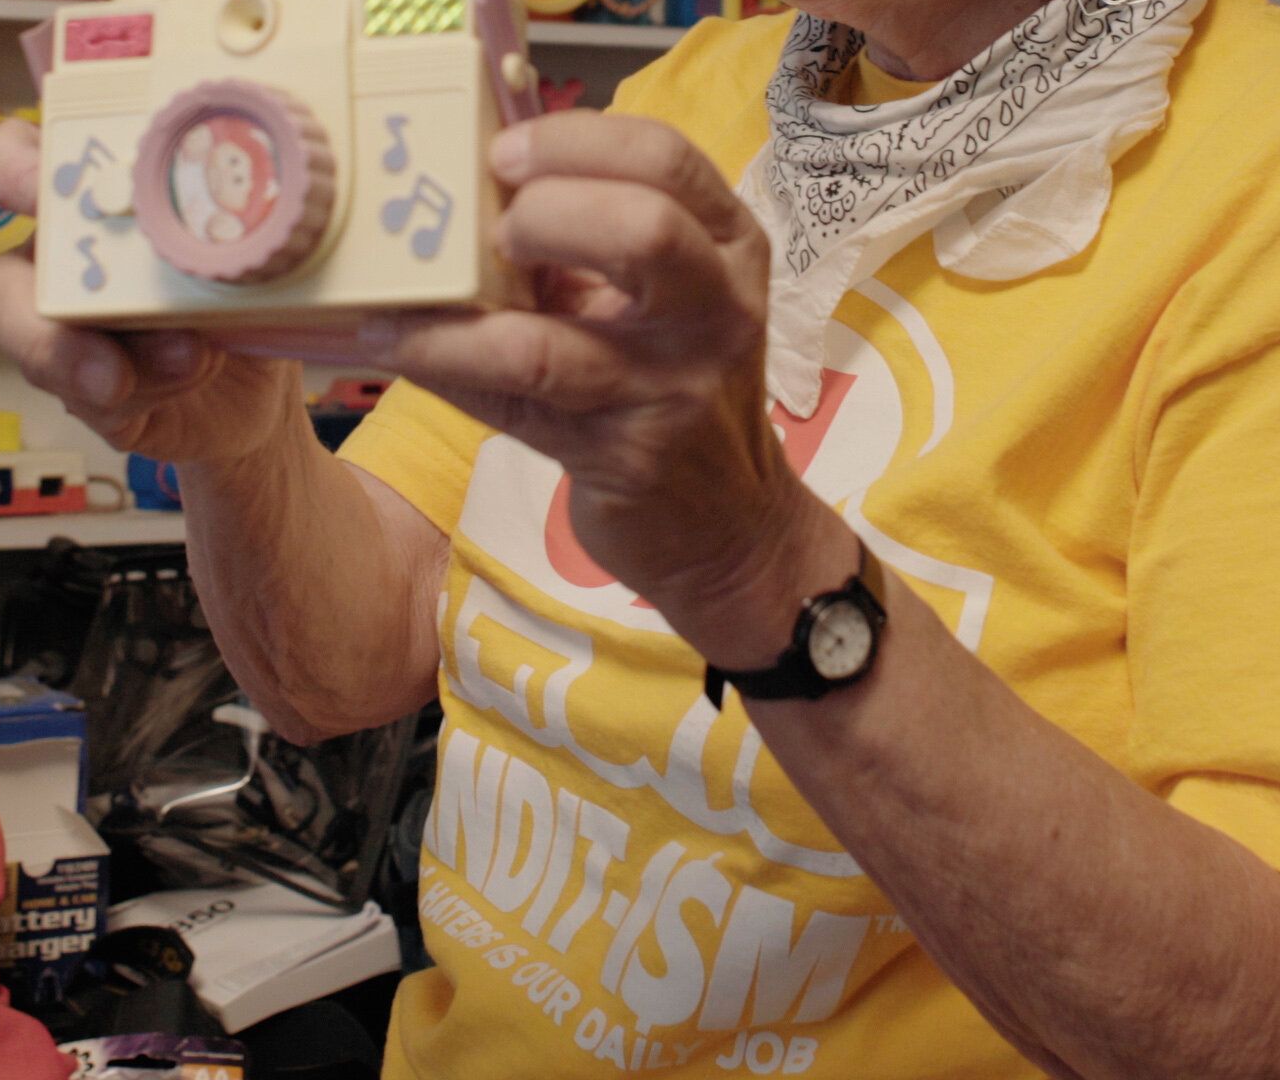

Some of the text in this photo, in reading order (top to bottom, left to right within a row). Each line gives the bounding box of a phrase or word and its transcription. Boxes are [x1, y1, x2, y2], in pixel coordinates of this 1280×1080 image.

[422, 881, 819, 1074] HATERS IS OUR DAILY JOB
